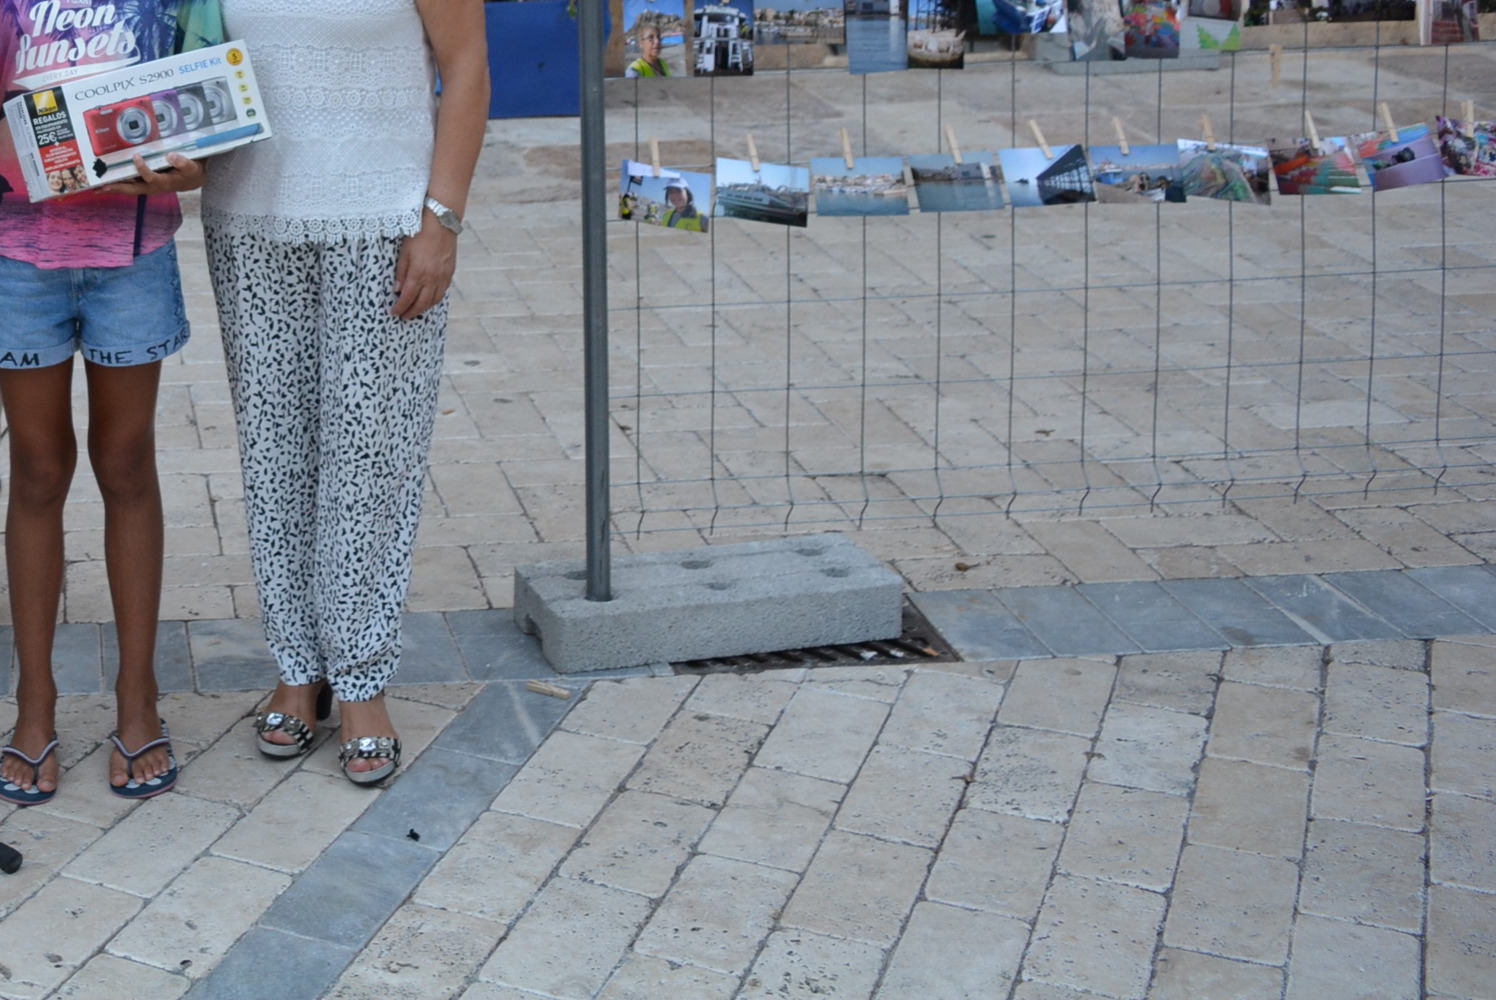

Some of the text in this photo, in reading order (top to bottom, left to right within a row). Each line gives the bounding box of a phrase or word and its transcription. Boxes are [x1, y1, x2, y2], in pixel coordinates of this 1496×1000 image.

[29, 0, 116, 38] Neon
[15, 18, 136, 75] Sunsets
[65, 68, 79, 77] DAY
[74, 56, 223, 101] COOLPIX S2900 SELFIE Kit
[33, 111, 67, 126] REGALOS
[37, 105, 59, 116] Nikon
[37, 131, 57, 146] 25€
[88, 348, 134, 365] THE
[146, 328, 190, 361] STAR
